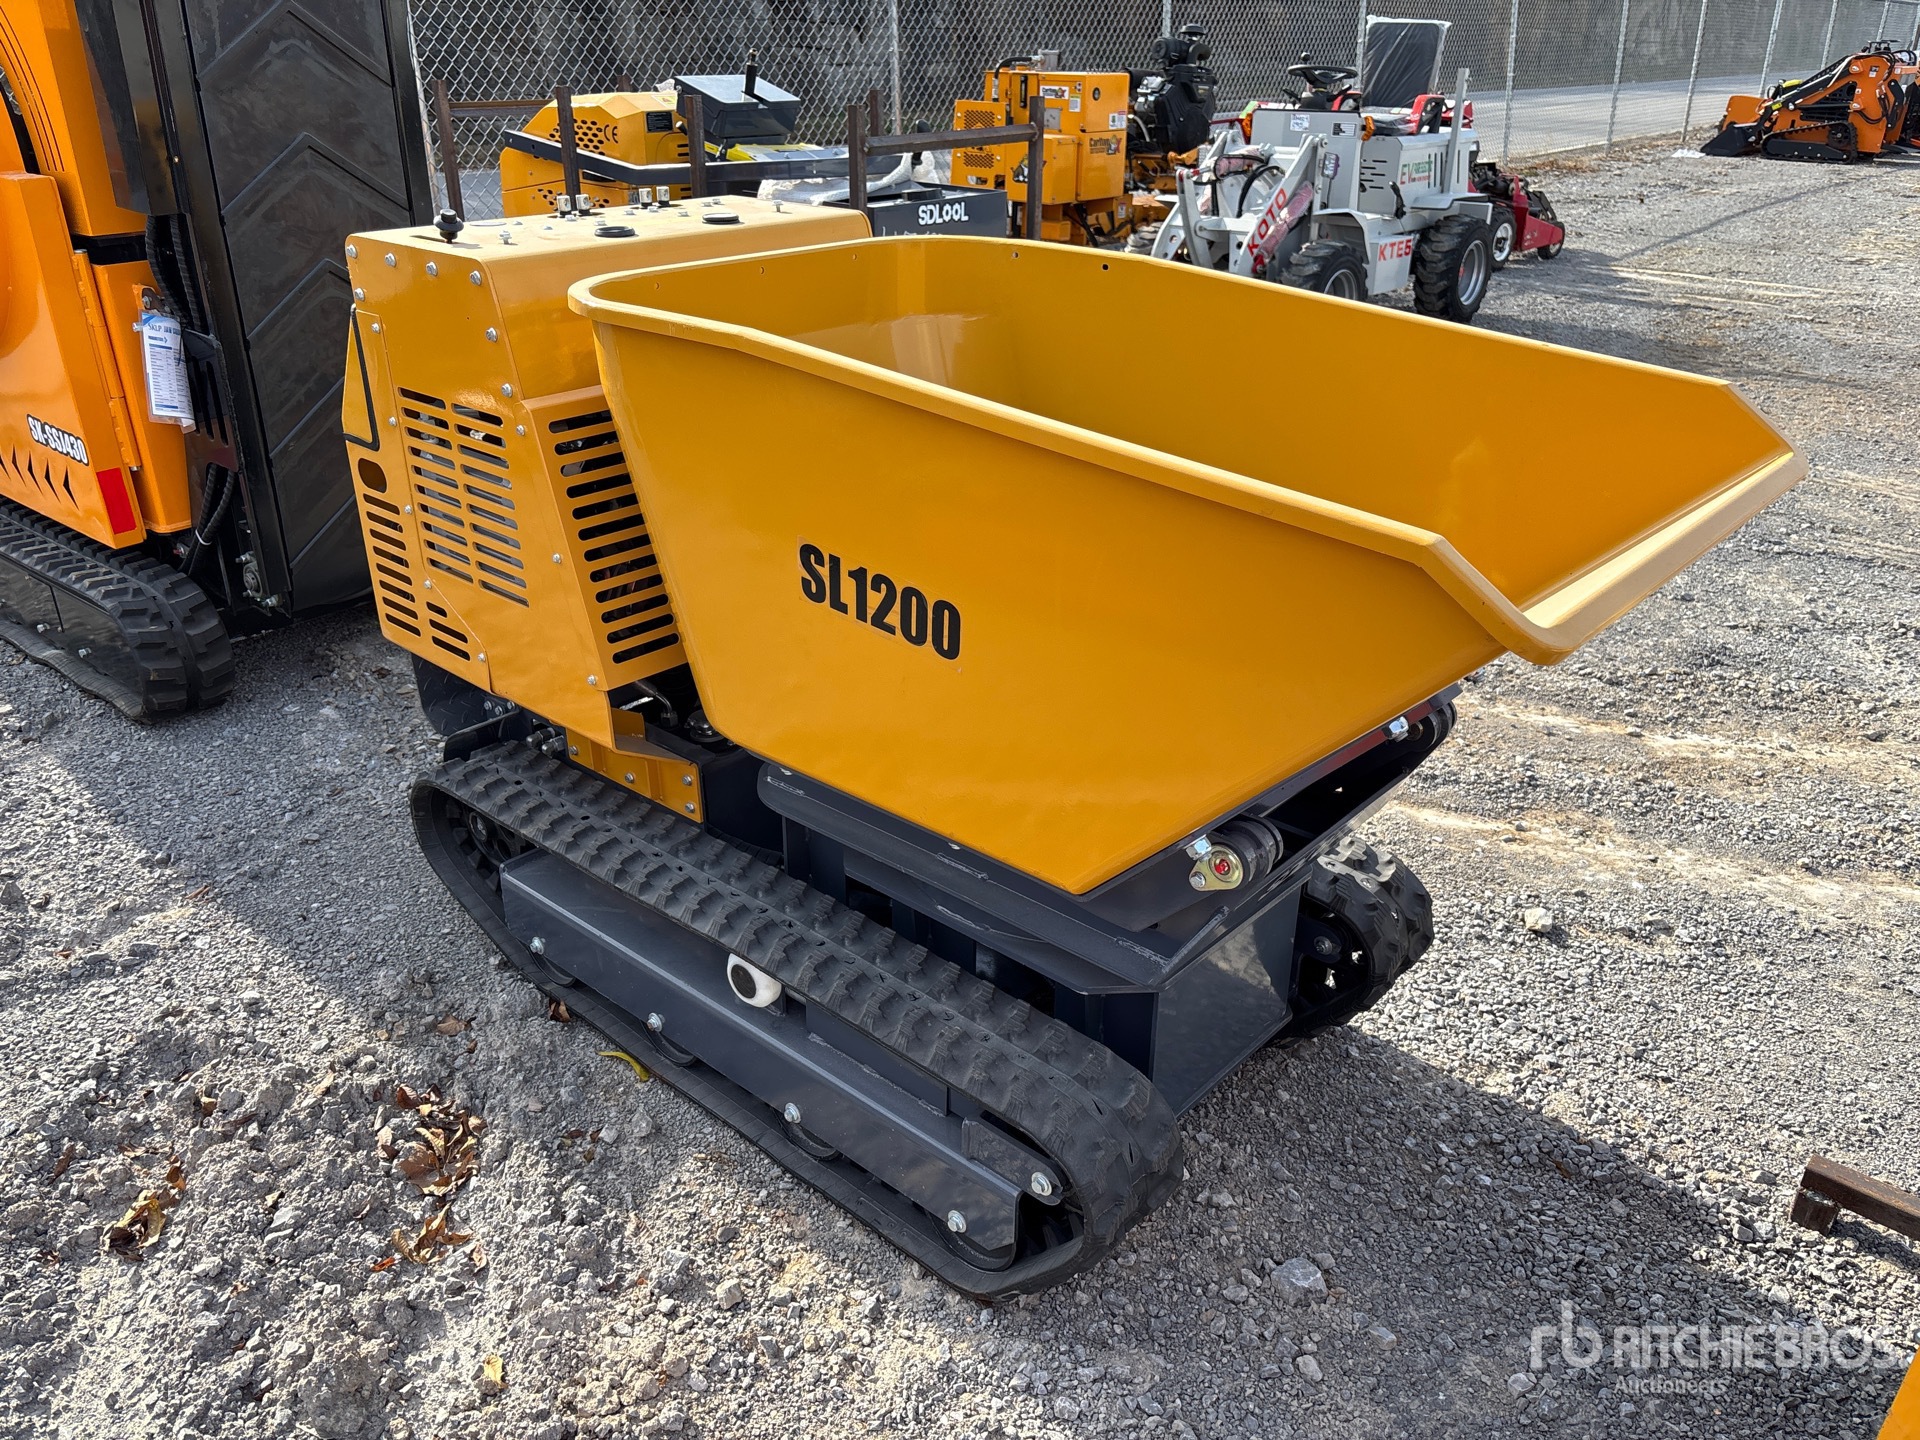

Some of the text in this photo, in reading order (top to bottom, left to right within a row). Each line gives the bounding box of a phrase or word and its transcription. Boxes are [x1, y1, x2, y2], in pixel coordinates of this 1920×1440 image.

[603, 124, 618, 144] CE
[1247, 187, 1287, 257] KOTO
[799, 543, 961, 660] SL1200
